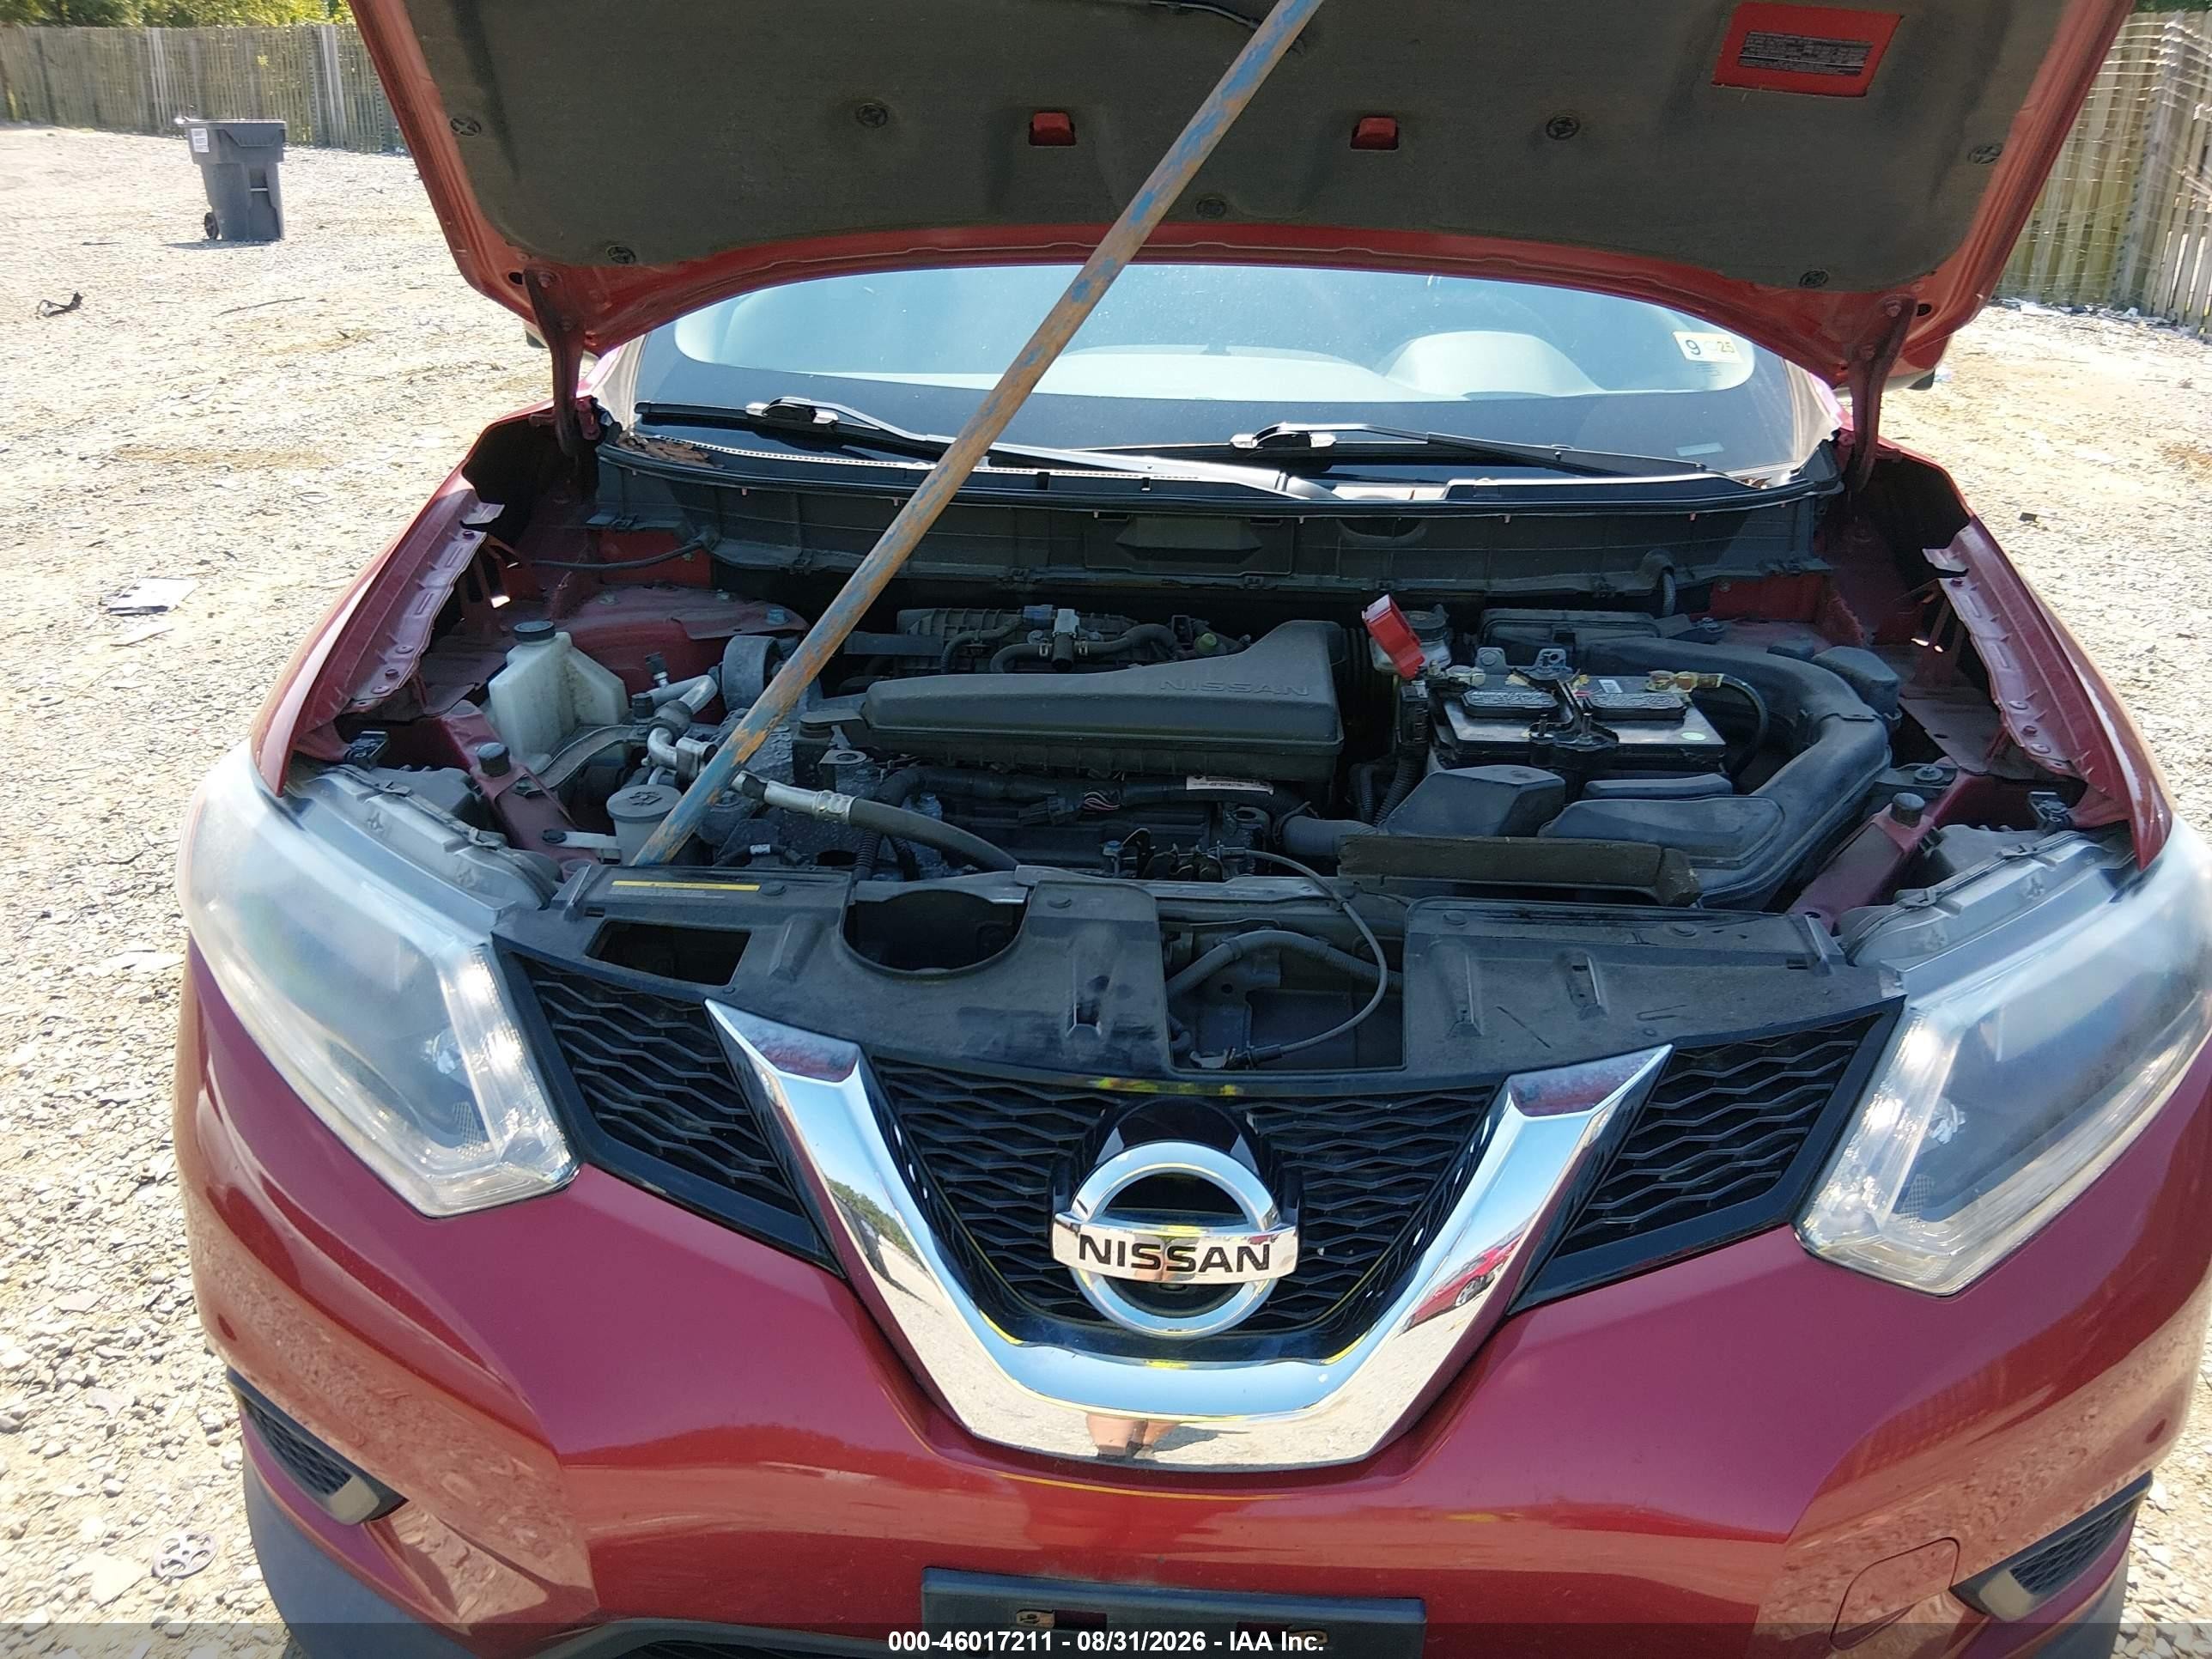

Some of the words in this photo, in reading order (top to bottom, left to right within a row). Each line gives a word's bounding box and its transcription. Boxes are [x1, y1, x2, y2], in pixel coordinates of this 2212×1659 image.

[1685, 339, 1701, 356] 9
[1717, 341, 1735, 354] 25
[1160, 679, 1310, 696] NISSAN
[1079, 1235, 1270, 1273] NISSAN
